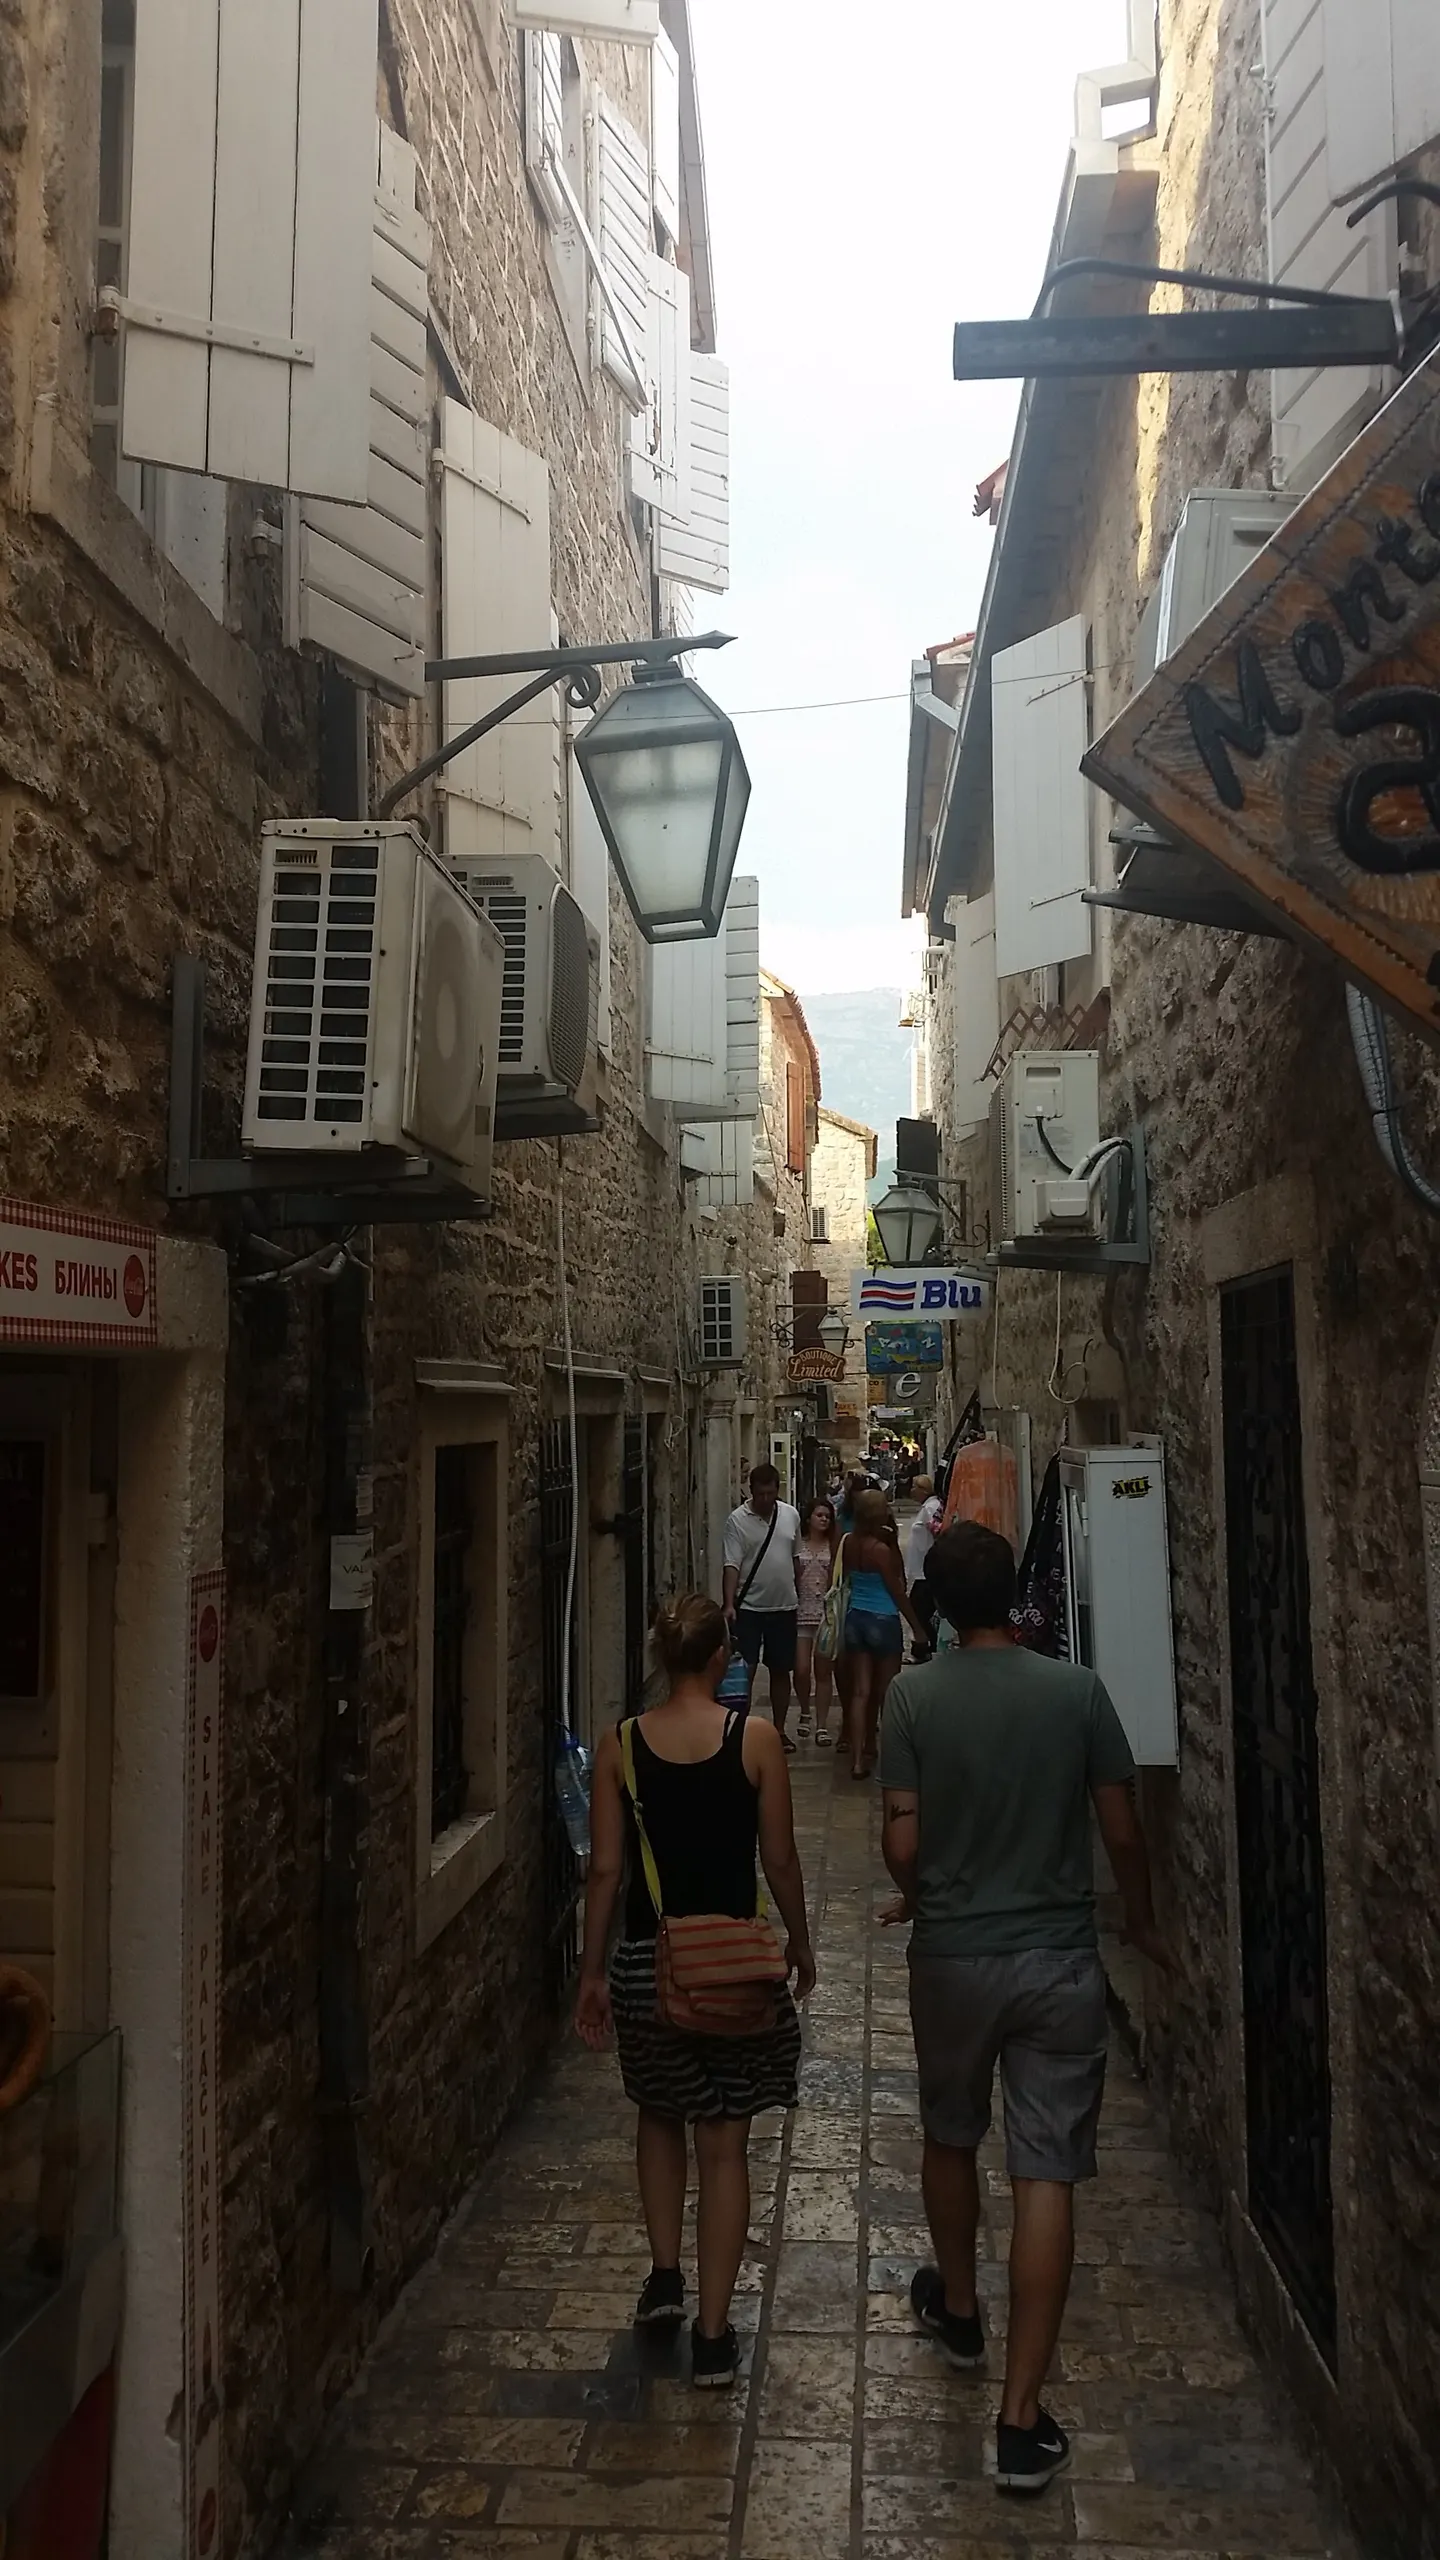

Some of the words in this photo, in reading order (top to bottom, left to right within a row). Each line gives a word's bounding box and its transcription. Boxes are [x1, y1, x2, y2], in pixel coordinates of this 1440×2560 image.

[55, 1260, 117, 1299] БЛИНЫ
[920, 1280, 982, 1309] Blu
[790, 1356, 844, 1378] Limited
[800, 1351, 838, 1364] BOUTIQUE
[895, 1371, 922, 1398] e
[201, 1716, 212, 1896] SLANE
[199, 1942, 211, 2264] PALAČINKE
